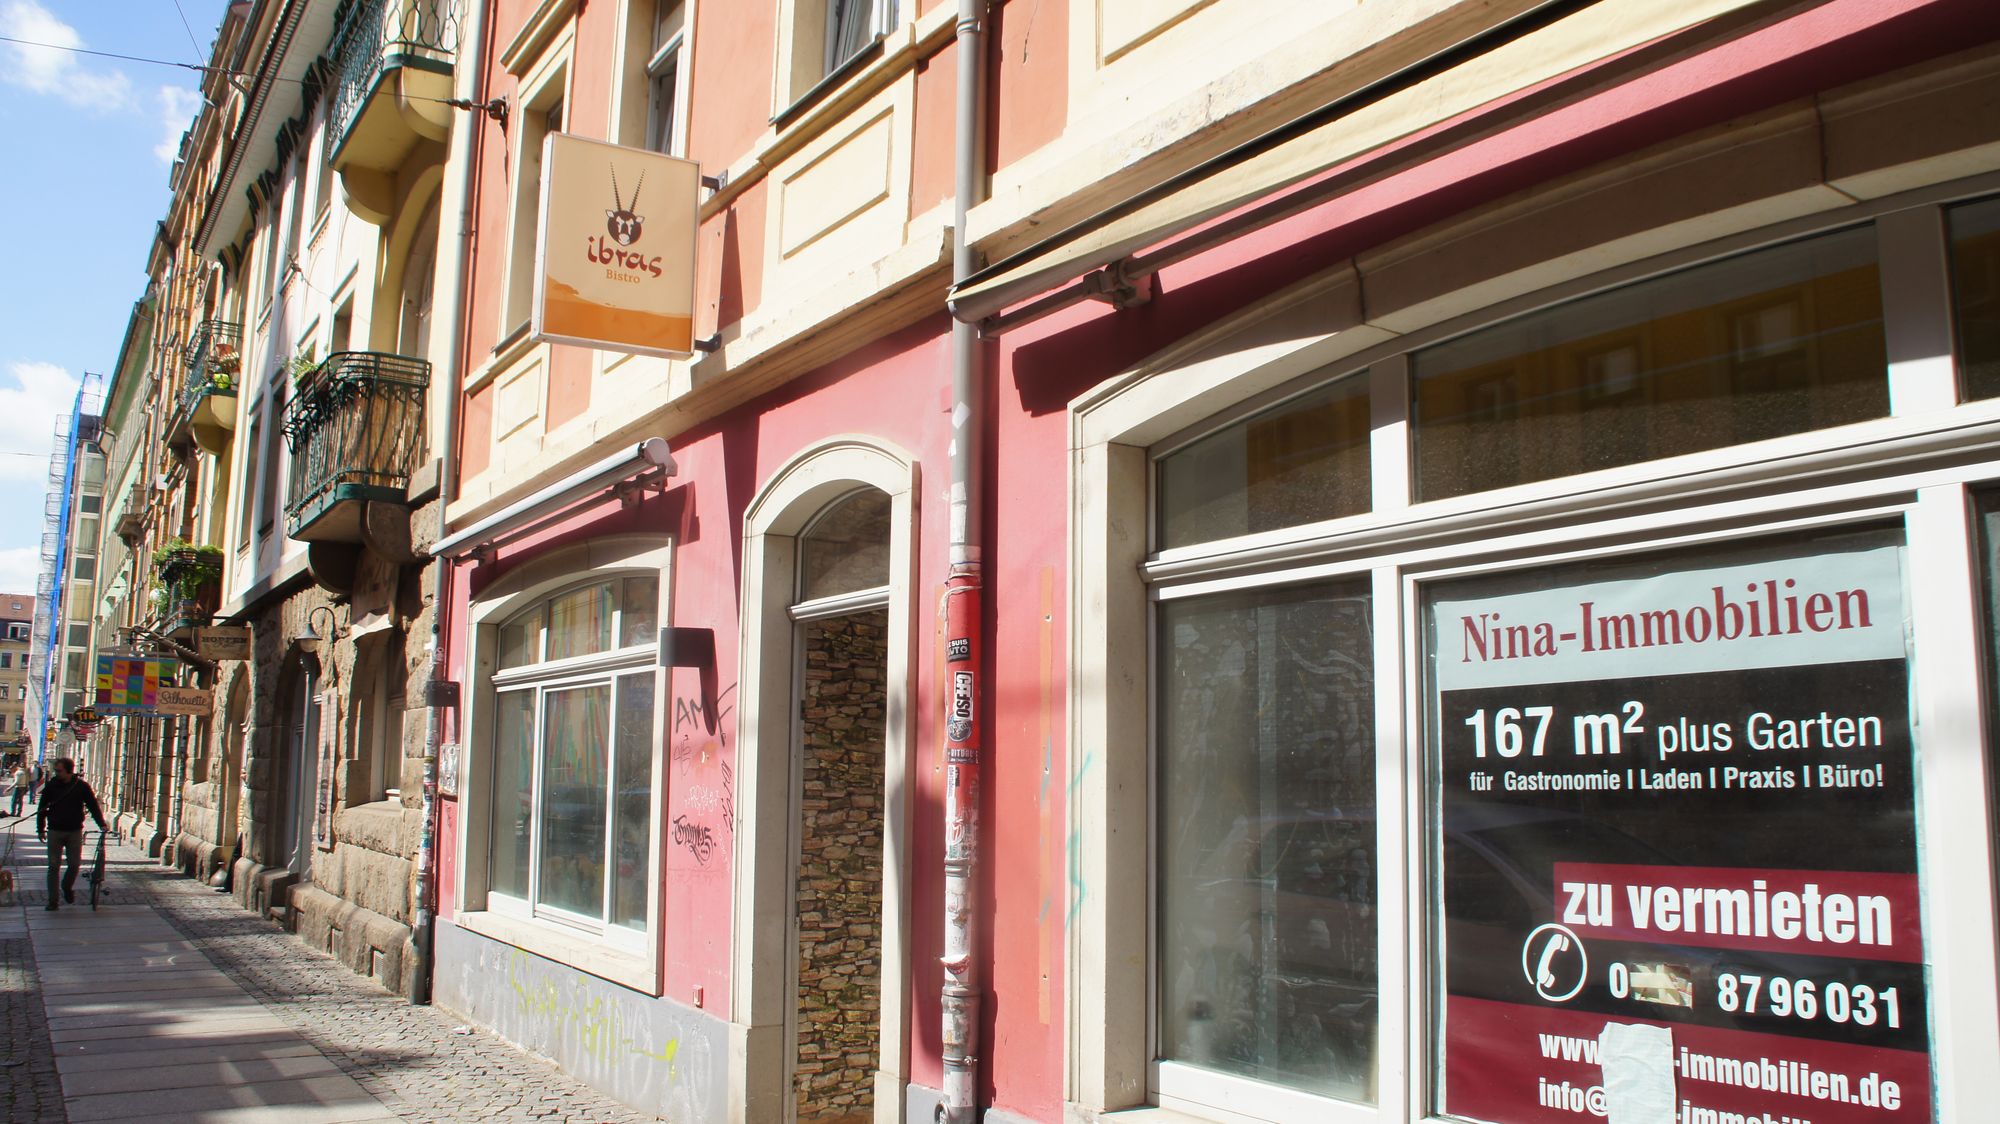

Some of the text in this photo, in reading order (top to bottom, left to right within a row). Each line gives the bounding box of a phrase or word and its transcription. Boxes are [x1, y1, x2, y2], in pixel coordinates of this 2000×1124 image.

[587, 235, 662, 278] ibras
[606, 269, 641, 284] Bistro
[1461, 579, 1873, 663] Nina-Immobilien
[160, 690, 208, 706] Silhouette
[1464, 705, 1553, 758] 167
[1658, 716, 1733, 760] plus
[1747, 710, 1883, 752] Garten
[1470, 771, 1494, 791] für
[1504, 769, 1621, 792] Gastronomie
[1640, 766, 1702, 791] Laden
[1723, 764, 1796, 791] Praxis
[1819, 763, 1884, 789] Büro!
[1561, 879, 1893, 946] zu vermieten
